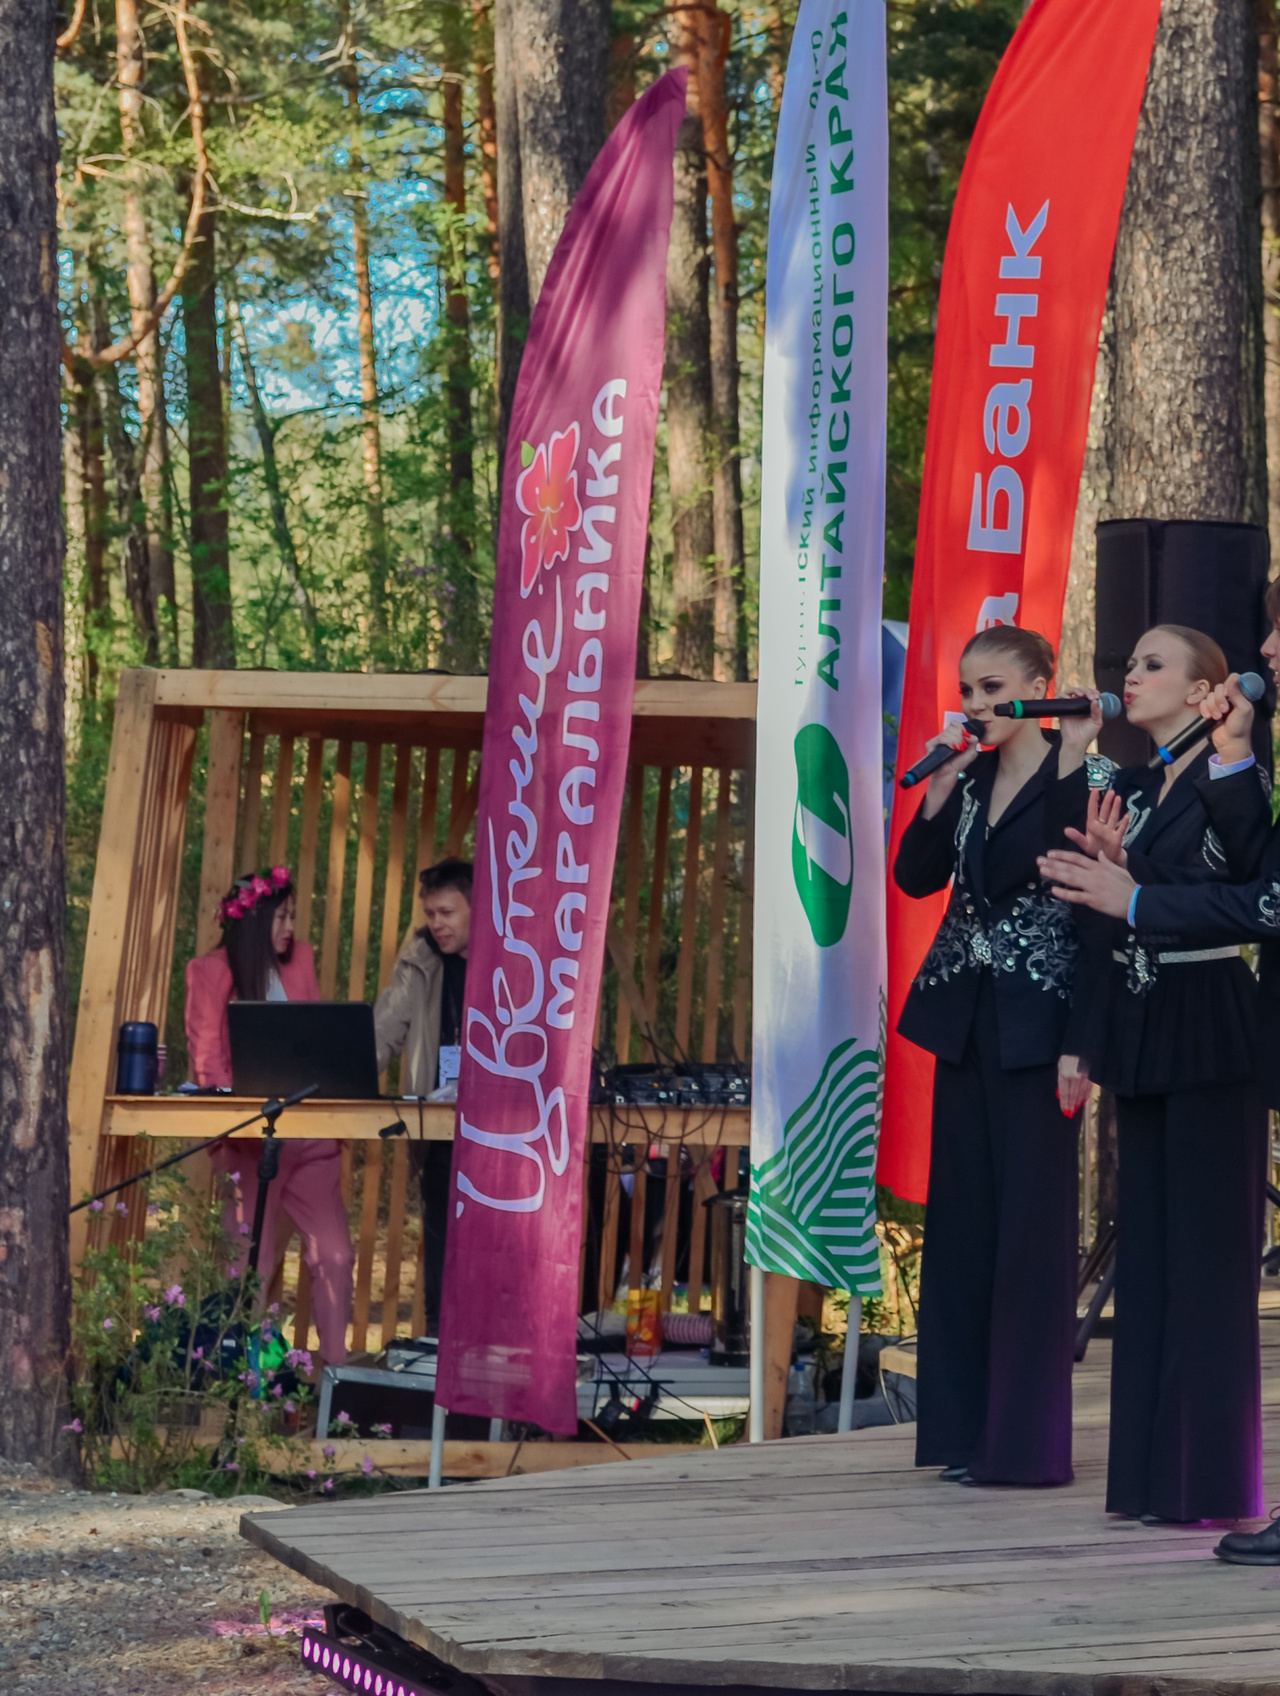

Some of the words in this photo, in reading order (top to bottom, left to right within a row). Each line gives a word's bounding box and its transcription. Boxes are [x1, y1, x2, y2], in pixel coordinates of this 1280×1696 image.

[825, 11, 853, 194] КРАЯ
[816, 222, 855, 692] АЛТАЙСКОГО
[967, 198, 1050, 554] Банк
[456, 575, 568, 1219] Цветение
[545, 378, 628, 1030] МАРАЛЬНИКА
